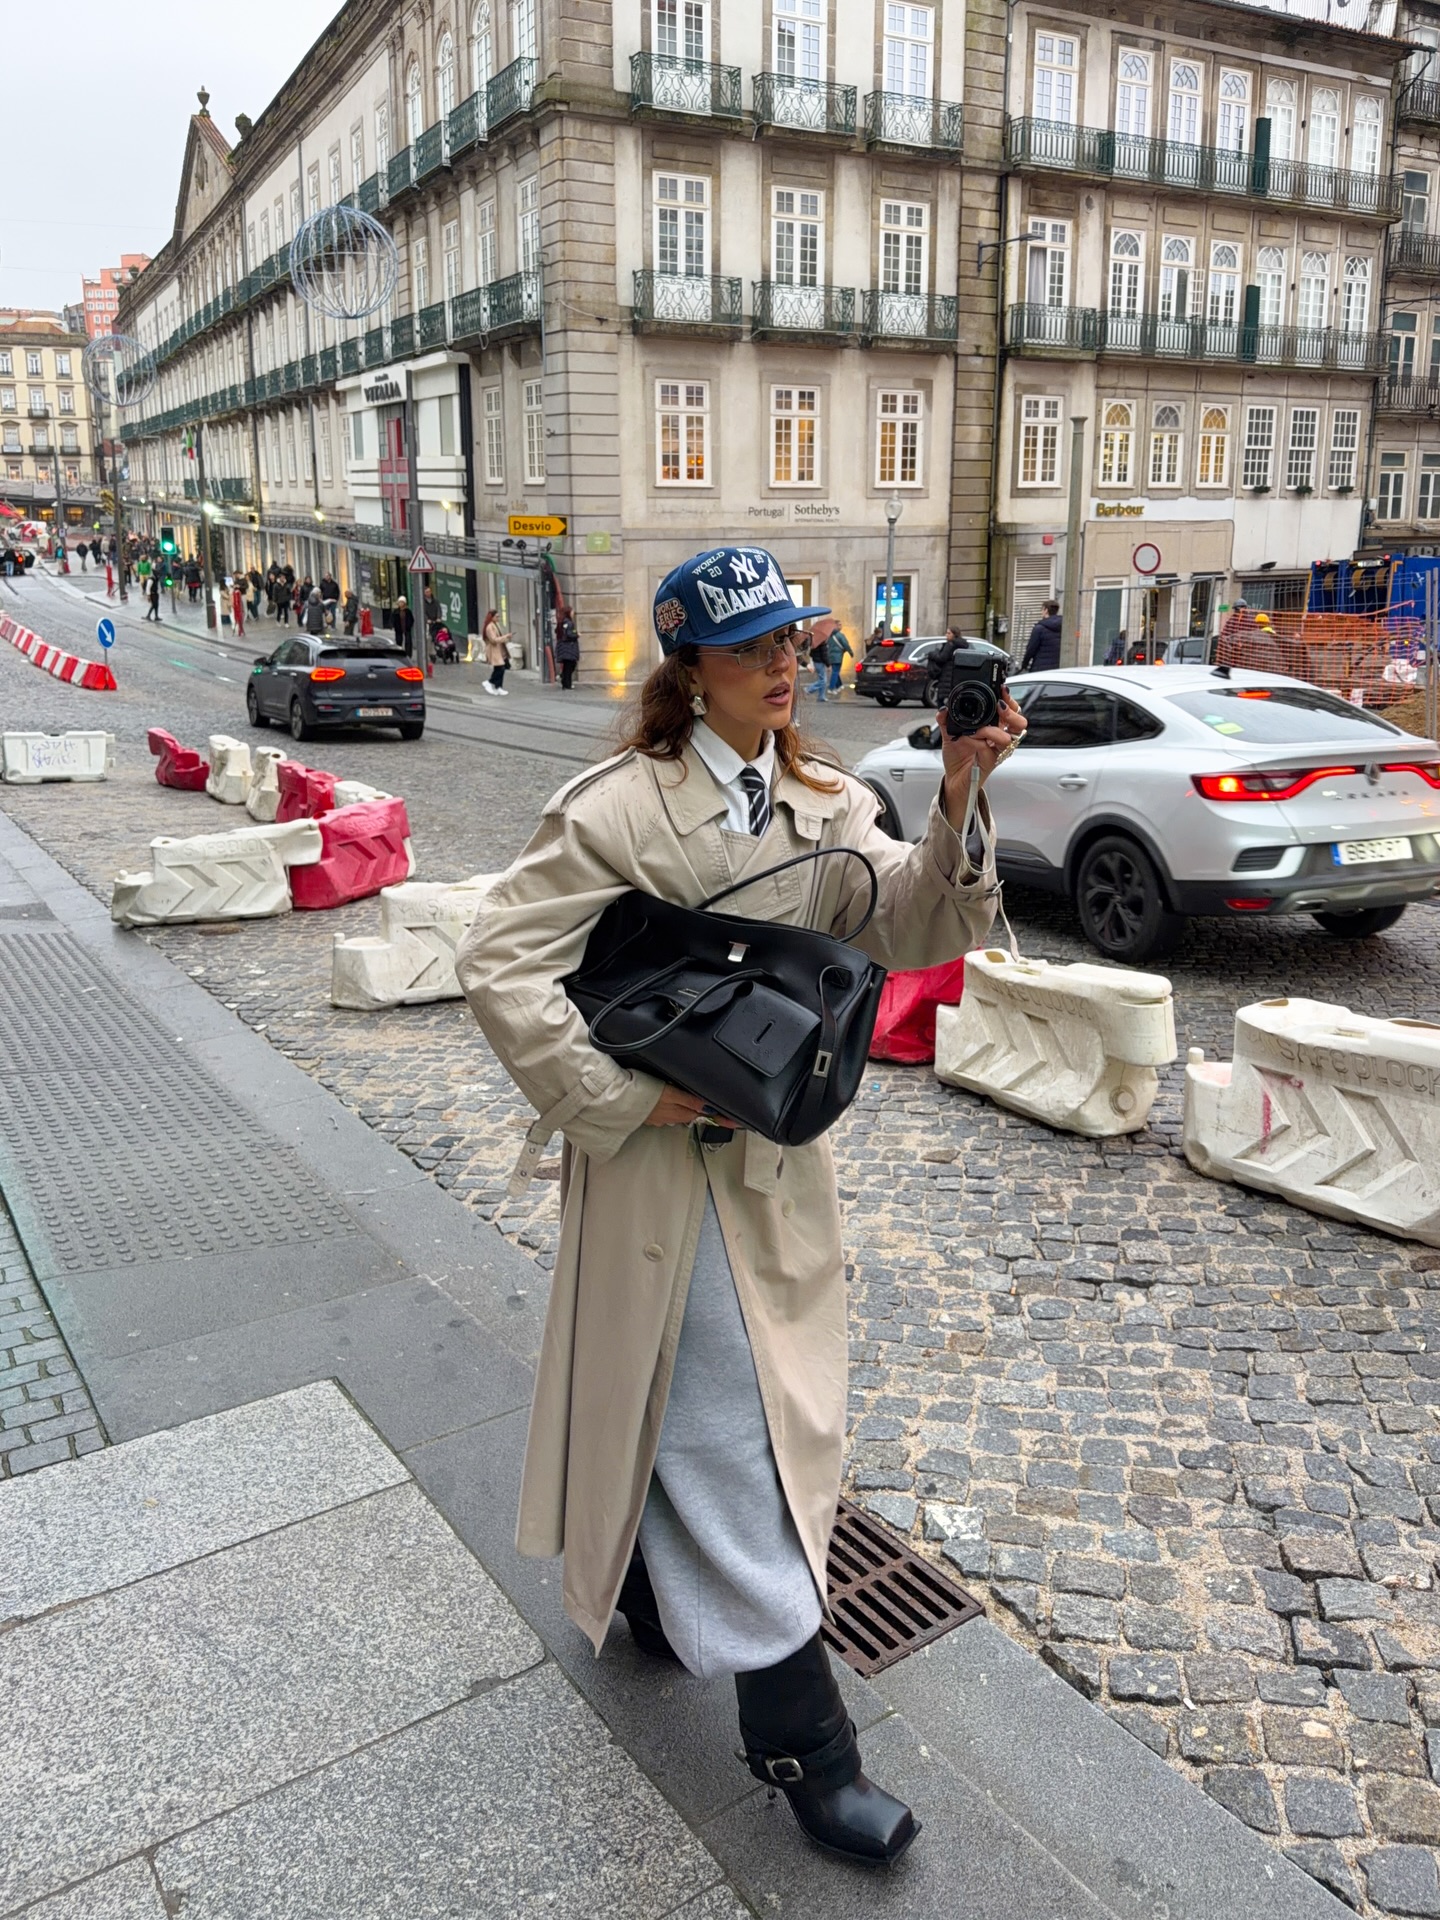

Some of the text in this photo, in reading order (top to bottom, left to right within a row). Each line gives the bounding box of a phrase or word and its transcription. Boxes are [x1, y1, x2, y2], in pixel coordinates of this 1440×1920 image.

[363, 381, 402, 403] VITALIA
[748, 503, 840, 519] Portugal Sotheby's
[1096, 502, 1145, 517] Barbour
[513, 520, 552, 531] Desvio
[692, 551, 725, 576] WORLD
[707, 565, 723, 578] 20
[656, 600, 679, 615] WORLD
[656, 607, 686, 627] SERIES
